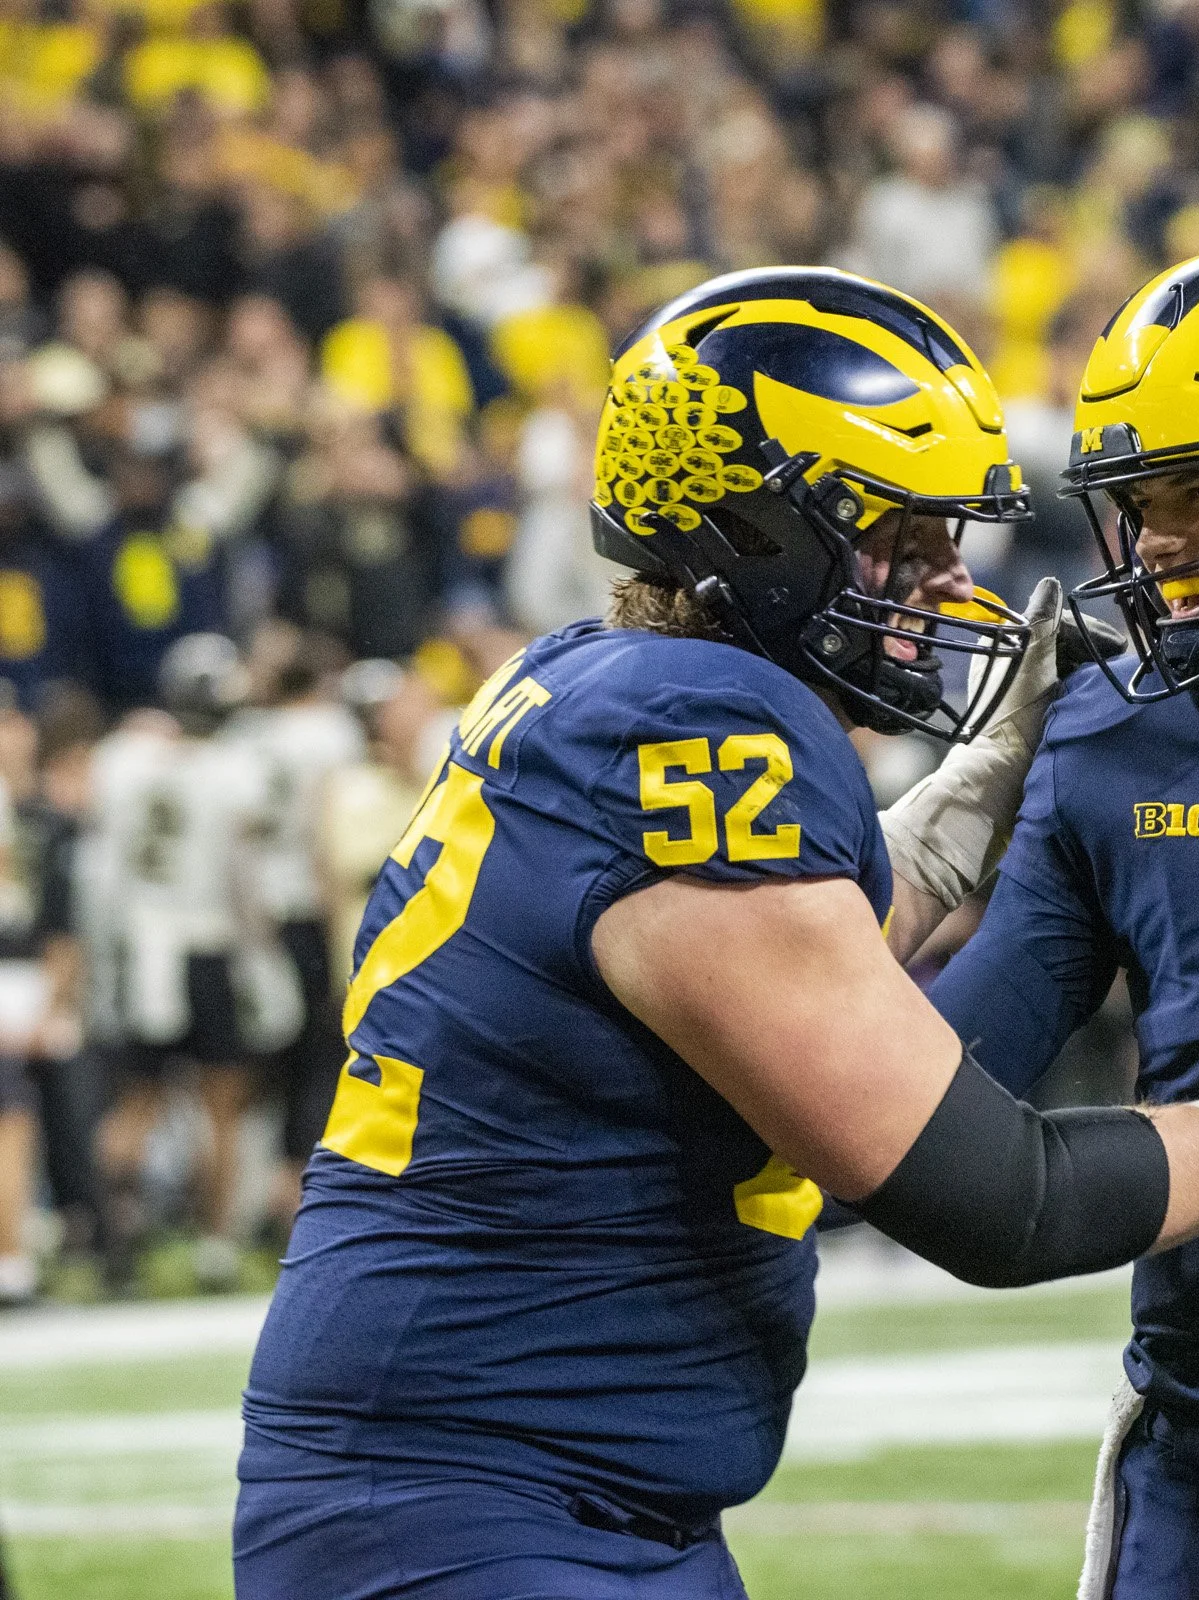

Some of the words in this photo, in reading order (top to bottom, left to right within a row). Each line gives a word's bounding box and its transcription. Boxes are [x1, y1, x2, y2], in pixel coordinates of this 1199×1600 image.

[1081, 426, 1104, 454] M
[638, 733, 801, 868] 52
[321, 742, 496, 1178] 2
